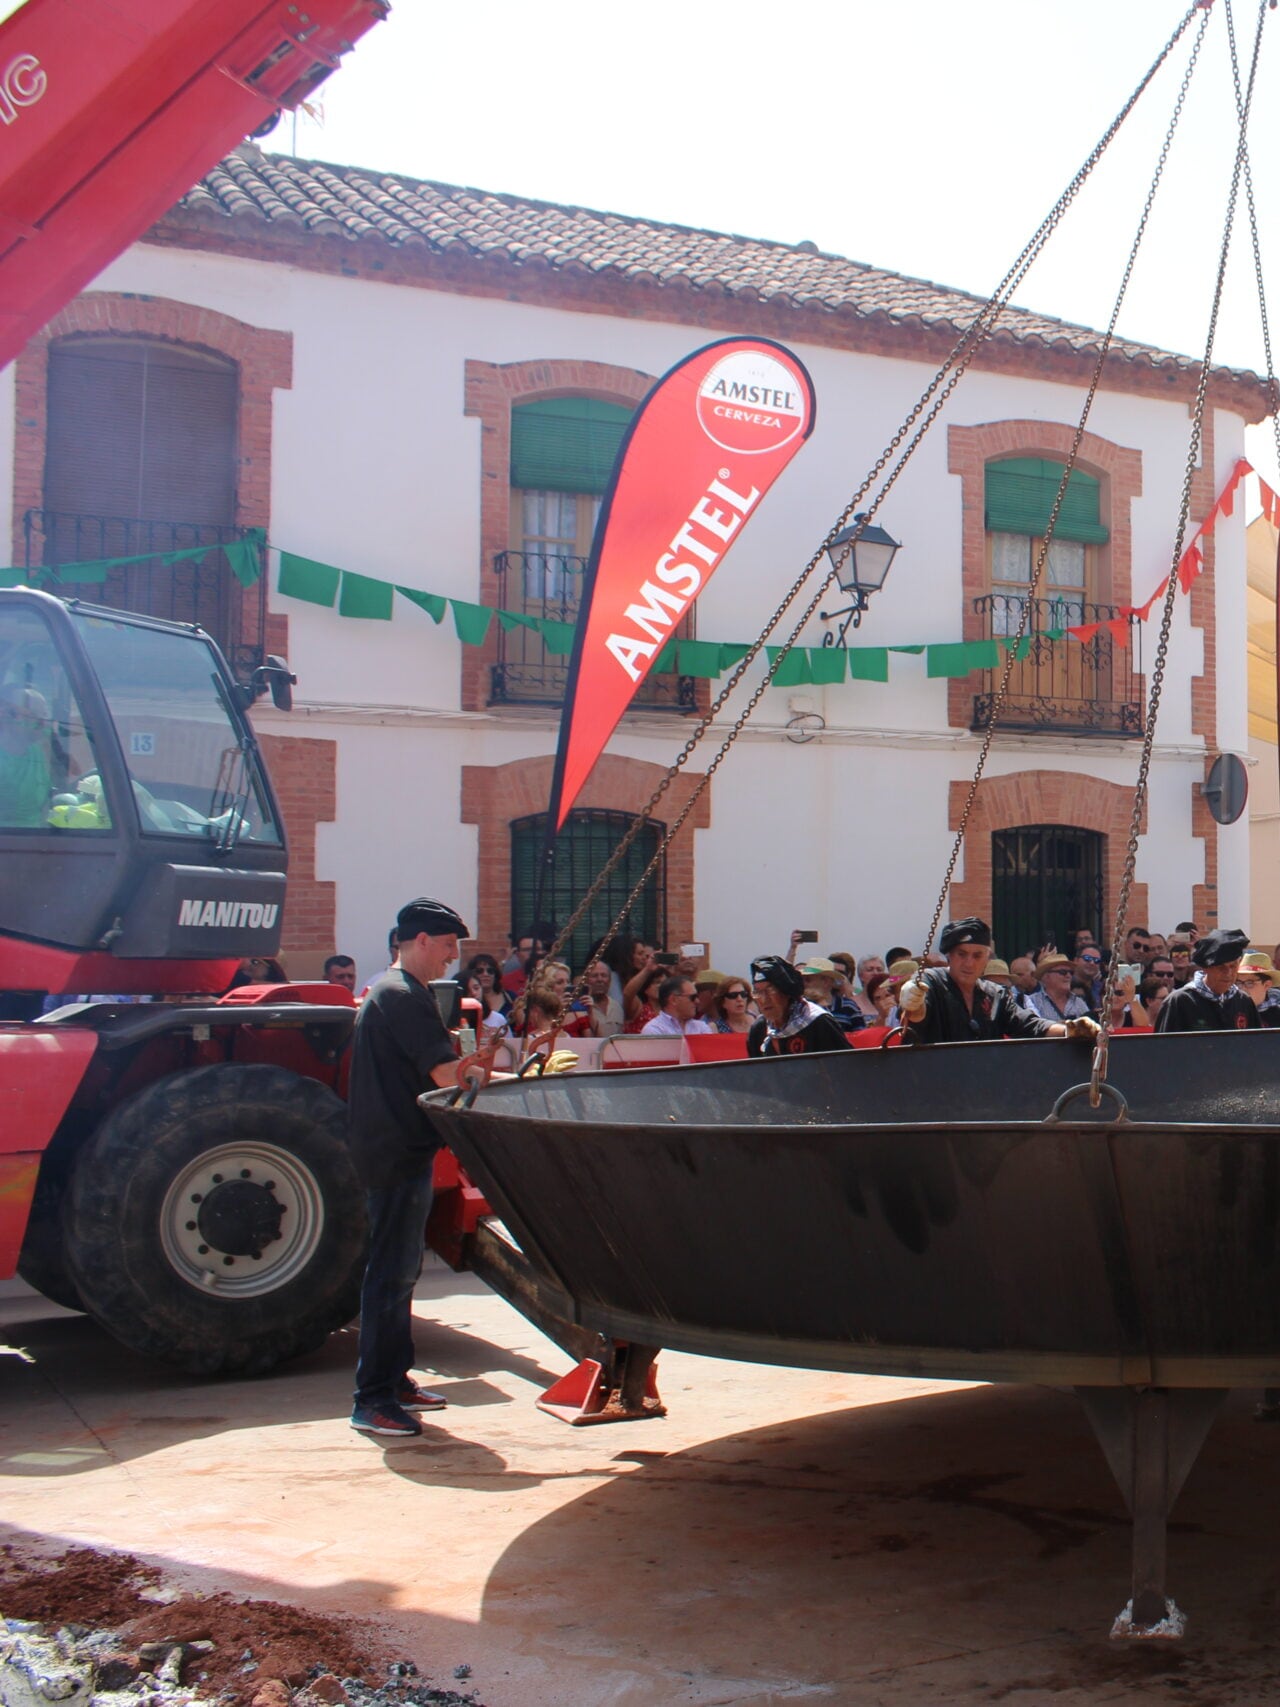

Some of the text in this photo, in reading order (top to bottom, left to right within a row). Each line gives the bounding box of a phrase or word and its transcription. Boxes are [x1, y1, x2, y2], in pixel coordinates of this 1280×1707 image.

[711, 378, 795, 410] AMSTEL
[713, 405, 782, 429] CERVEZA
[133, 734, 153, 752] 13
[178, 899, 279, 929] MANITOU
